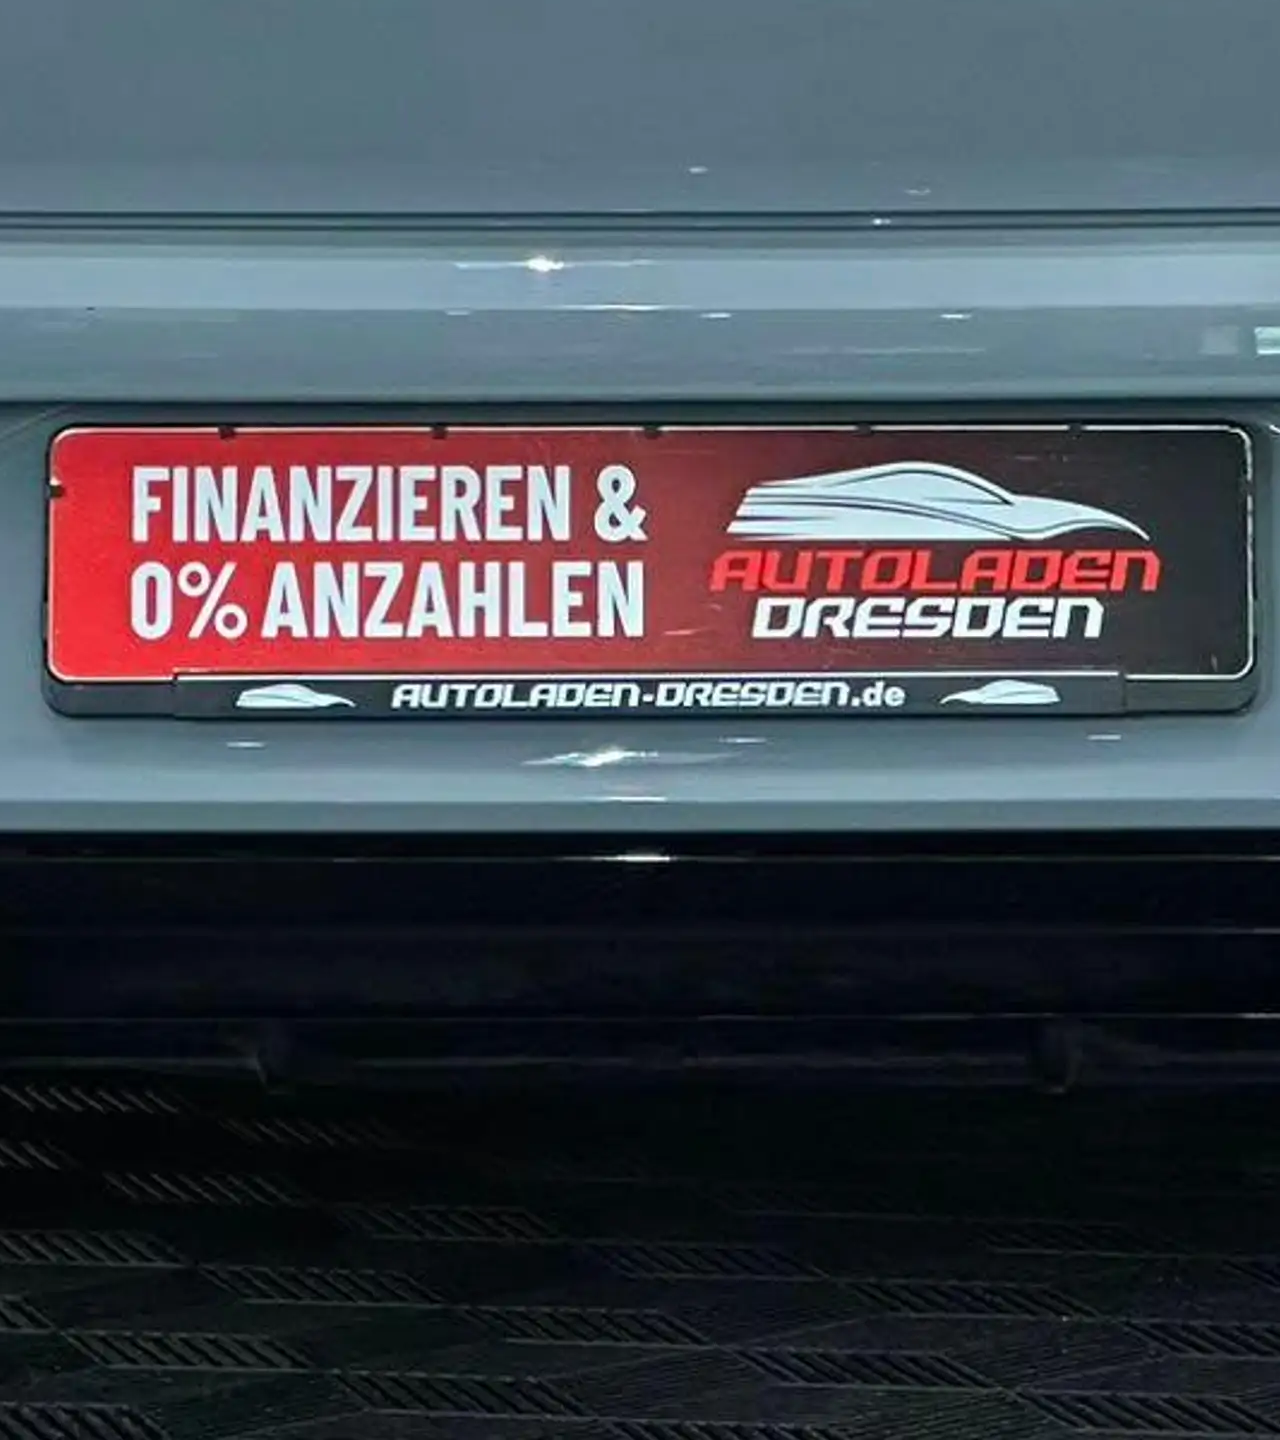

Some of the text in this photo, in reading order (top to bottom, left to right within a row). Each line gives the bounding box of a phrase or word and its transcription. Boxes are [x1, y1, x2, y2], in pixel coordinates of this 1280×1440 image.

[131, 464, 648, 543] FINANZIEREN &
[710, 548, 1160, 592] AUTOLADEN
[130, 560, 644, 640] 0% ANZAHLEN
[751, 595, 1104, 639] DRESDEN
[390, 679, 906, 709] AUTOLADEN-DRESDEN.de
